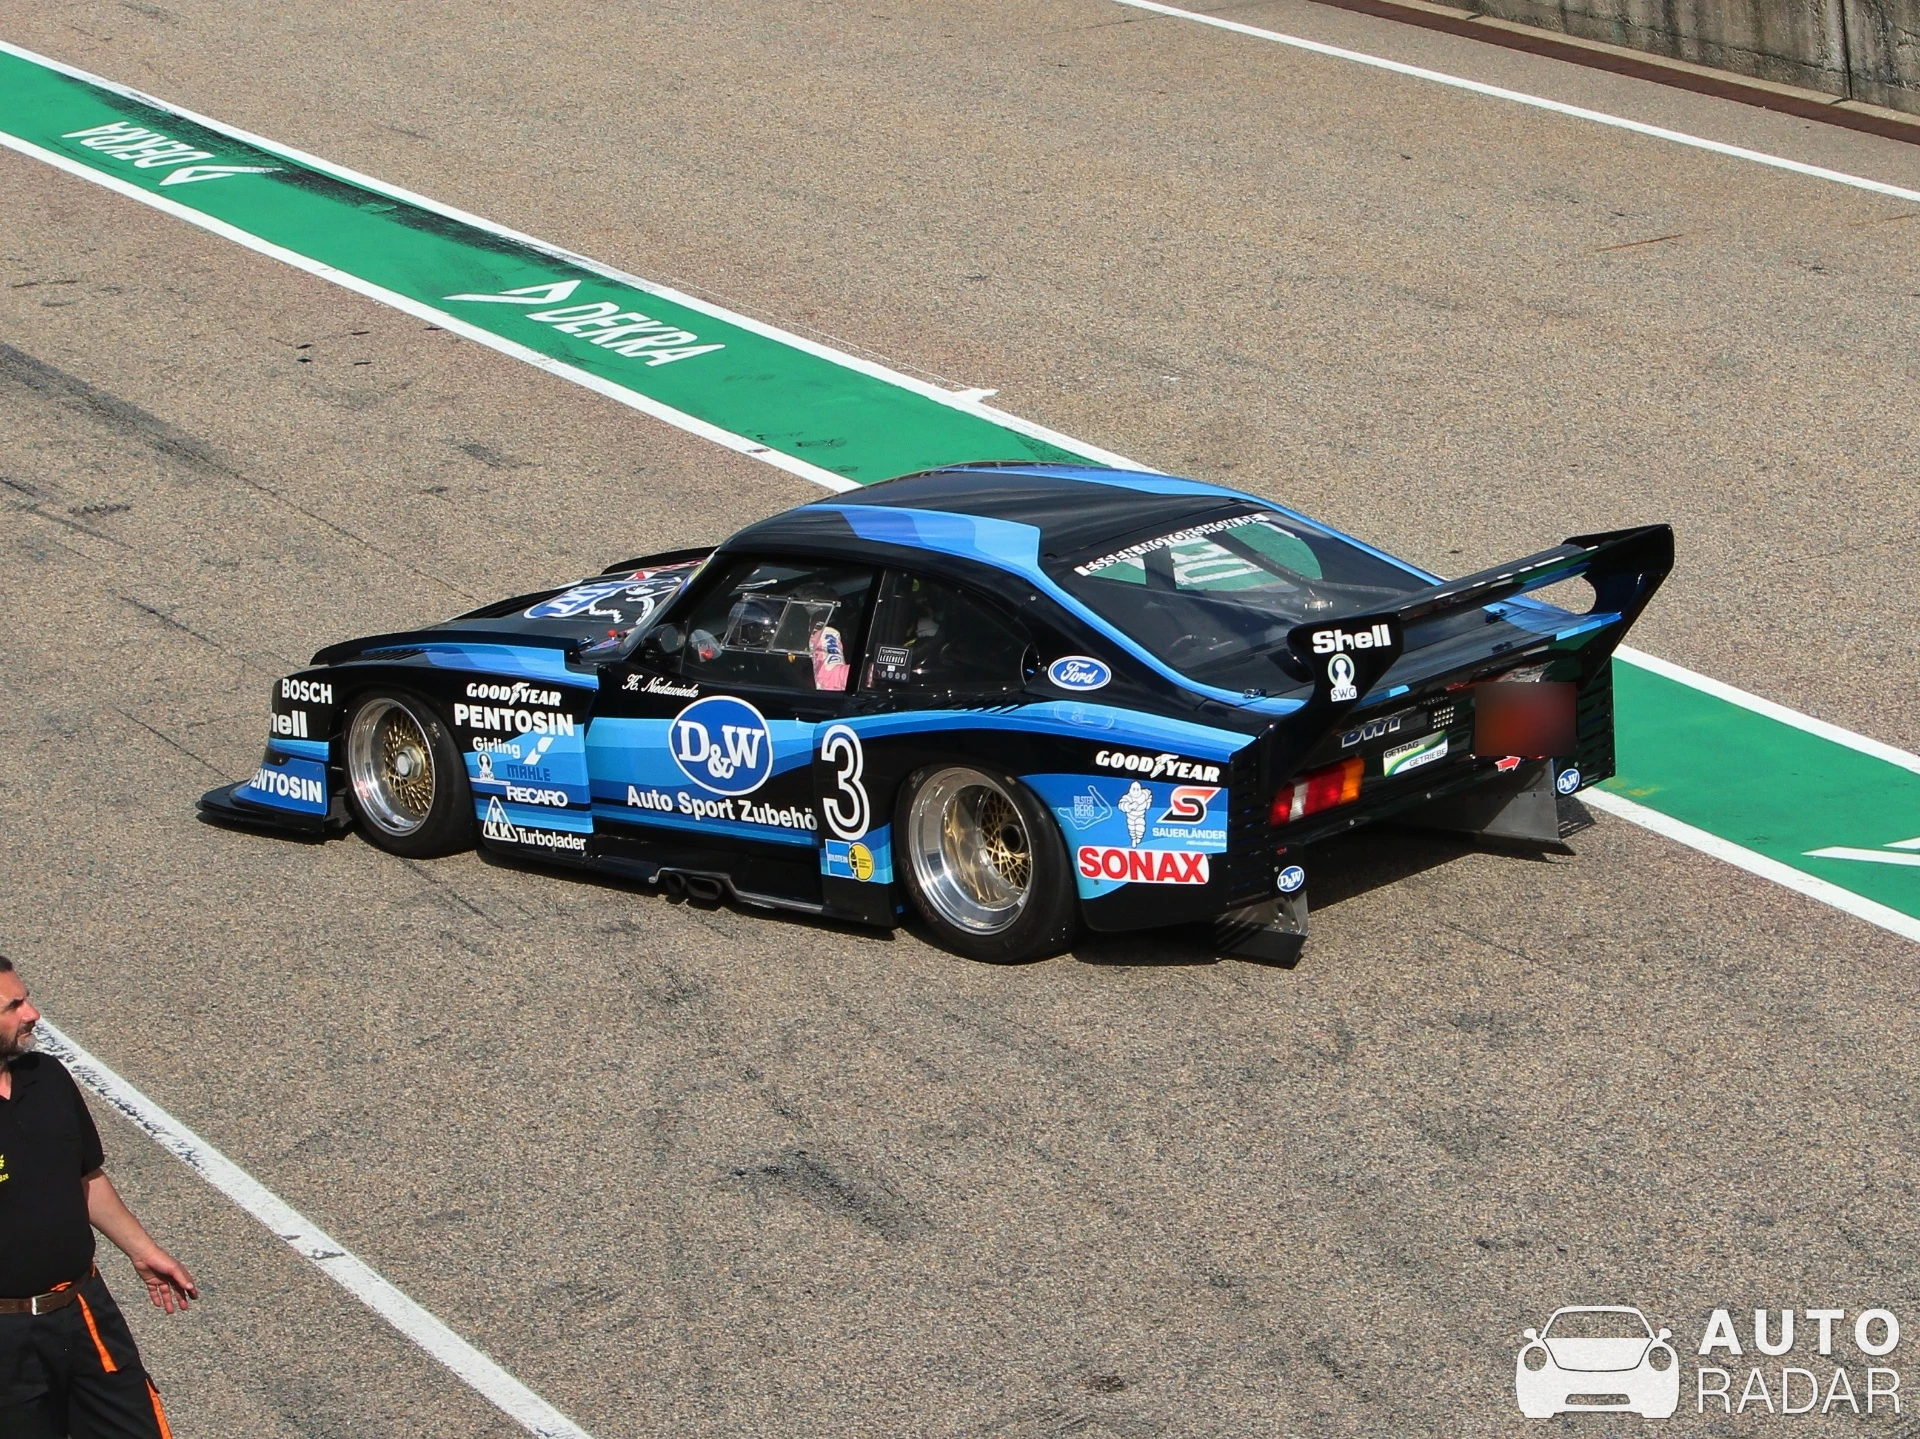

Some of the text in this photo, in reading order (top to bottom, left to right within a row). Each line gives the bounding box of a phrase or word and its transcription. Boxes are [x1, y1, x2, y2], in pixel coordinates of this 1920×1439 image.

[61, 121, 216, 169] DEKRA
[525, 301, 727, 368] DEKRA
[1312, 624, 1392, 654] Shell
[1059, 661, 1097, 685] Ford
[282, 678, 333, 705] BOSCH
[466, 681, 562, 707] GOODYEAR
[1332, 687, 1357, 700] SWG
[454, 703, 575, 737] PENTOSIN
[472, 736, 521, 759] Girling
[677, 720, 765, 780] D&W
[1384, 740, 1421, 759] GETRAG
[1409, 747, 1447, 767] GETRIEBE
[480, 771, 494, 780] SWG
[507, 764, 551, 782] MAHLE
[1095, 750, 1221, 783] GOODYEAR
[247, 767, 323, 804] ENTOSIN
[821, 724, 871, 841] 3
[1559, 771, 1579, 791] D&W
[506, 785, 568, 807] RECARO
[627, 785, 818, 831] Auto Sport Zubehö
[1073, 795, 1094, 805] BILSTER
[1074, 804, 1095, 818] BERG
[516, 827, 587, 851] Turbolader
[1152, 827, 1227, 840] SAUERLÄNDER
[1079, 847, 1207, 884] SONAX
[1279, 870, 1302, 889] D&W
